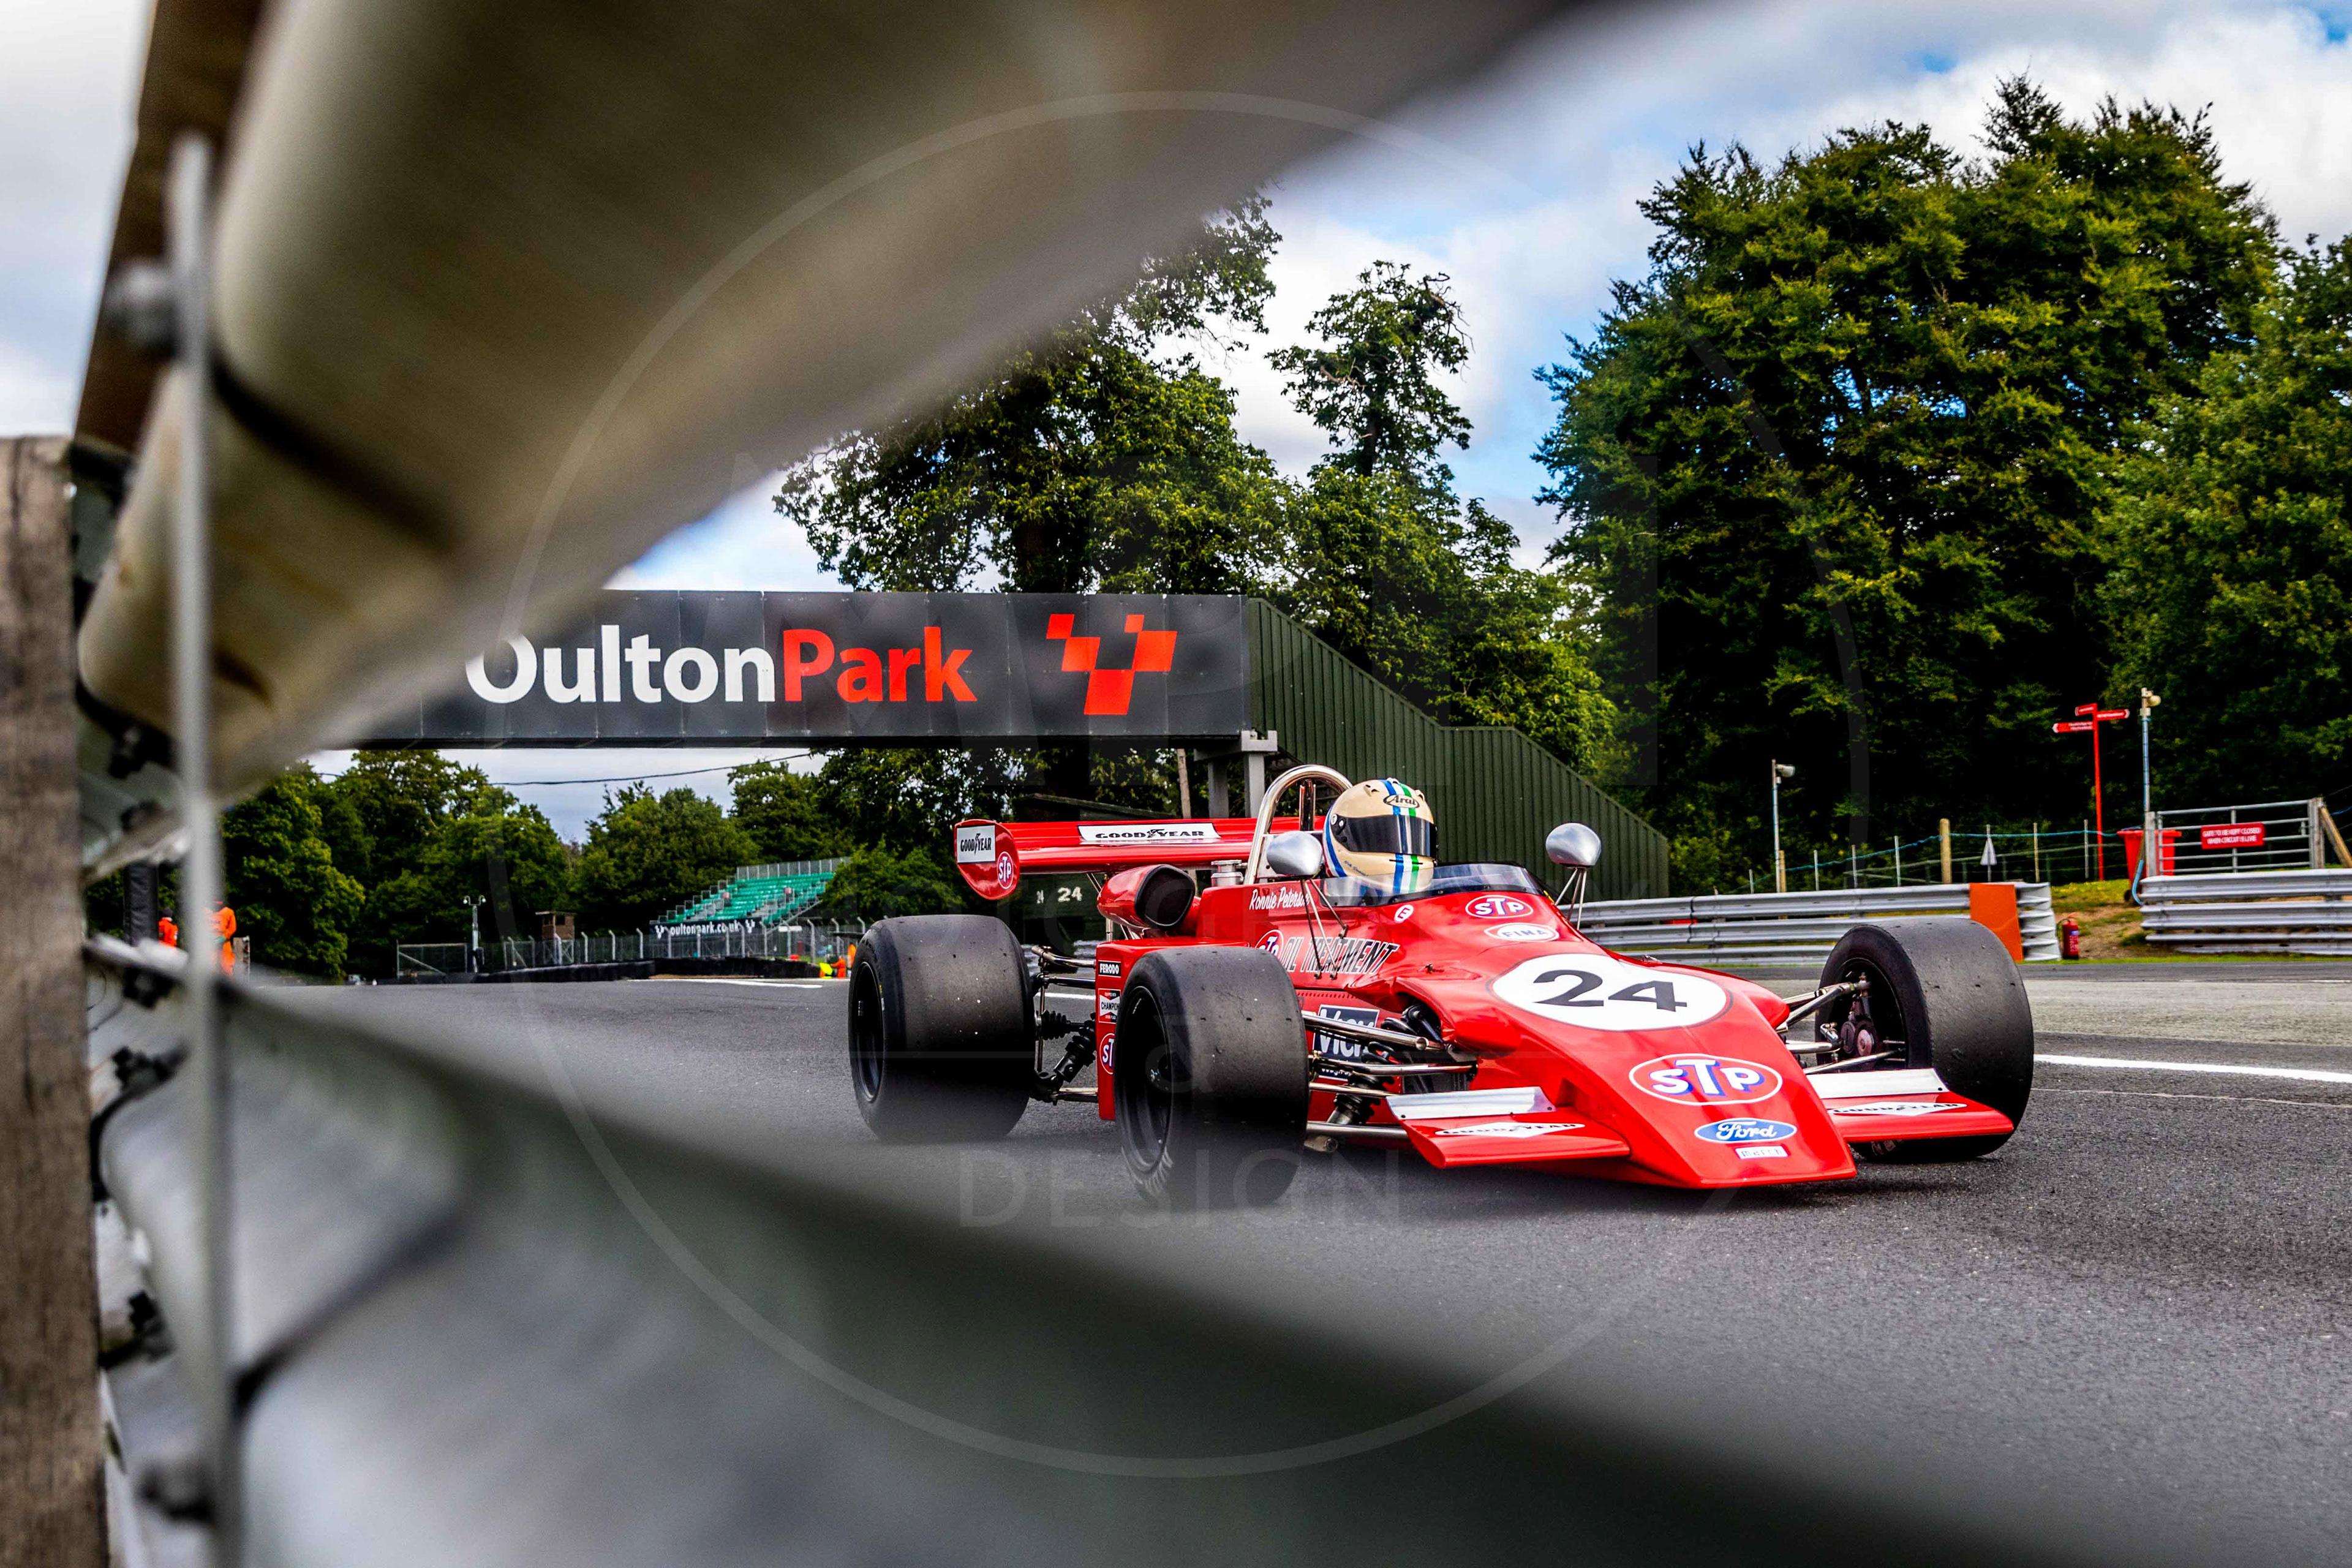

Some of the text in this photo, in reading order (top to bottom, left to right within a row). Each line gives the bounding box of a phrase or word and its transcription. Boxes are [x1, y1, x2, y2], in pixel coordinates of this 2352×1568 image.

[1387, 794, 1416, 805] Arai
[998, 856, 1012, 882] STP
[1057, 886, 1083, 902] 24
[1249, 889, 1277, 910] Ronnie
[1474, 898, 1525, 915] STP
[1502, 927, 1549, 938] FINA
[1282, 937, 1304, 973] OIL
[1300, 937, 1401, 974] TREATMENT
[1099, 963, 1119, 974] FERODO
[1533, 970, 1687, 1012] 24
[1102, 1038, 1115, 1067] ST
[1649, 1059, 1765, 1096] STP
[1716, 1121, 1777, 1140] Ford
